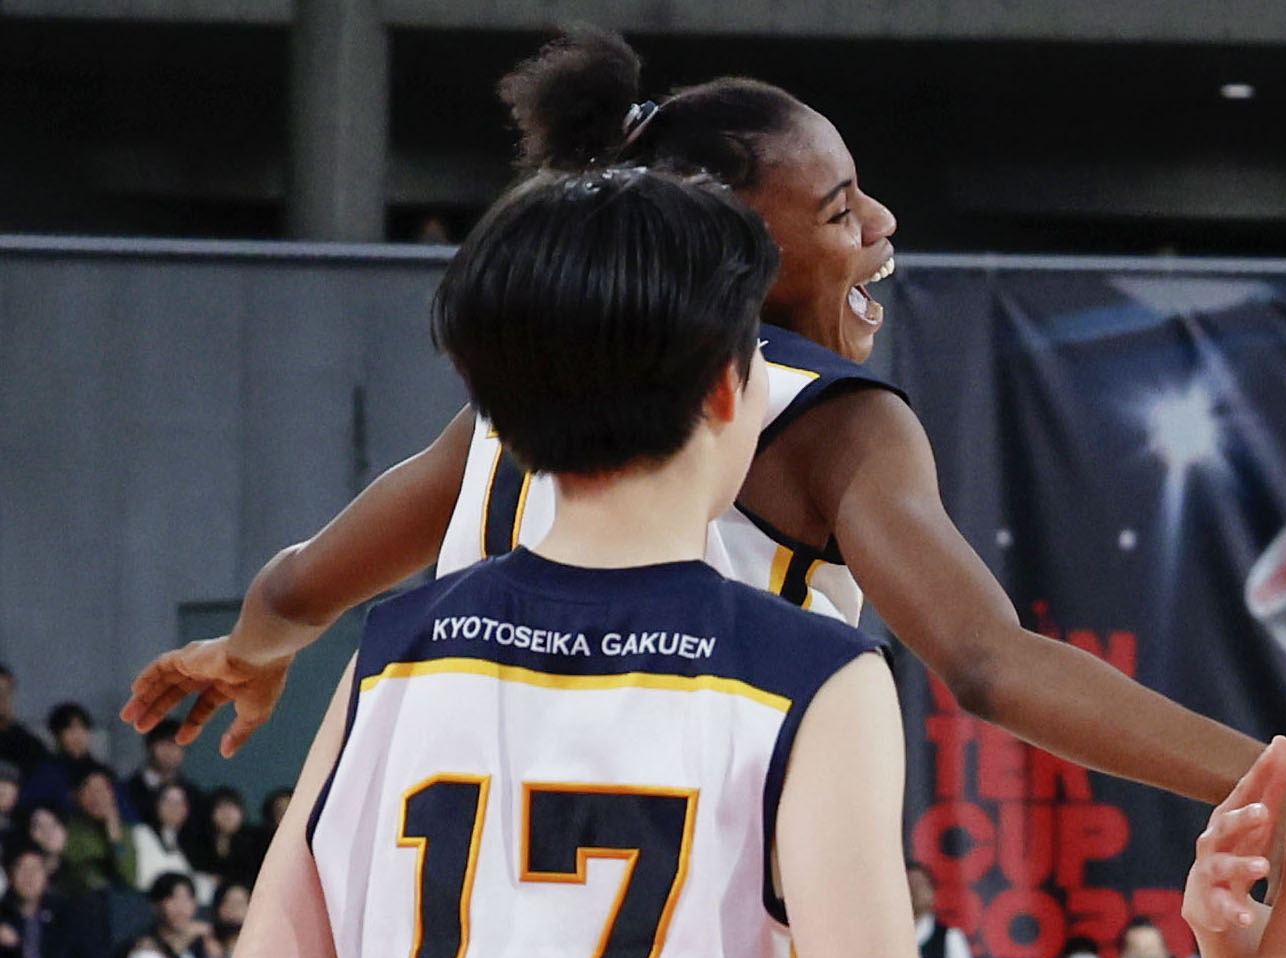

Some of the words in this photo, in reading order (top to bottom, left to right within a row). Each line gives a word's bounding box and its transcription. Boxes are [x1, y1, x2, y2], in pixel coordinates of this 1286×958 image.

[432, 616, 591, 657] KYOTOSEIKA
[601, 631, 716, 659] GAKUEN
[912, 801, 1130, 890] CUP
